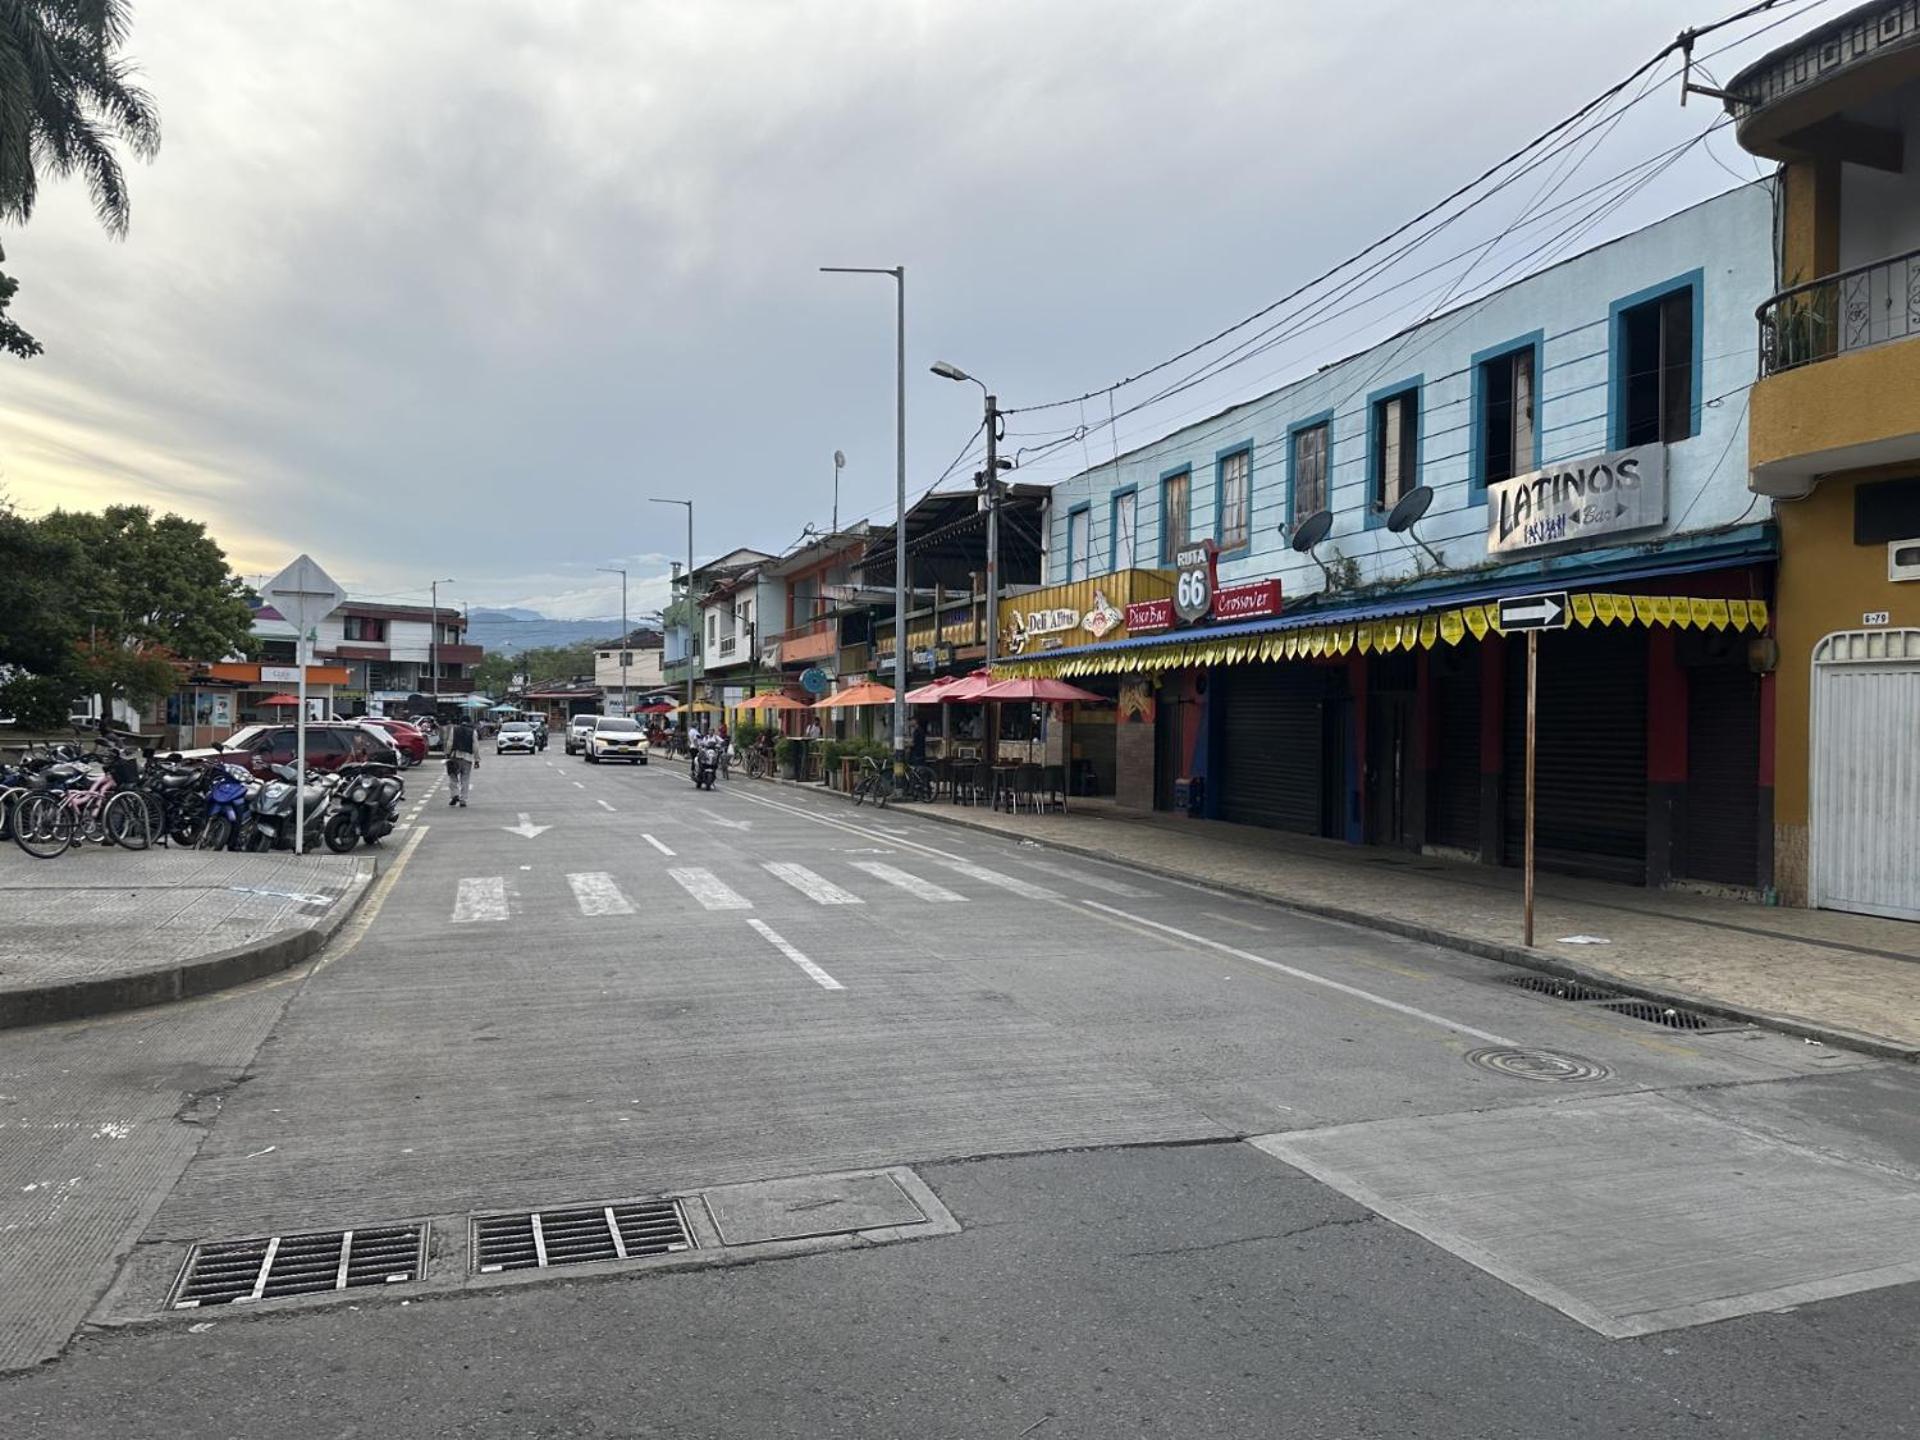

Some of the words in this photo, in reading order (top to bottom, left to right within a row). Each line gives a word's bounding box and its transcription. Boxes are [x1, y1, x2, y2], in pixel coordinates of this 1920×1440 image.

[1498, 458, 1642, 544] LATINOS
[1177, 548, 1207, 567] RUTA
[1178, 570, 1206, 609] 66
[1217, 590, 1270, 613] Crossover
[1029, 612, 1047, 633] Deli
